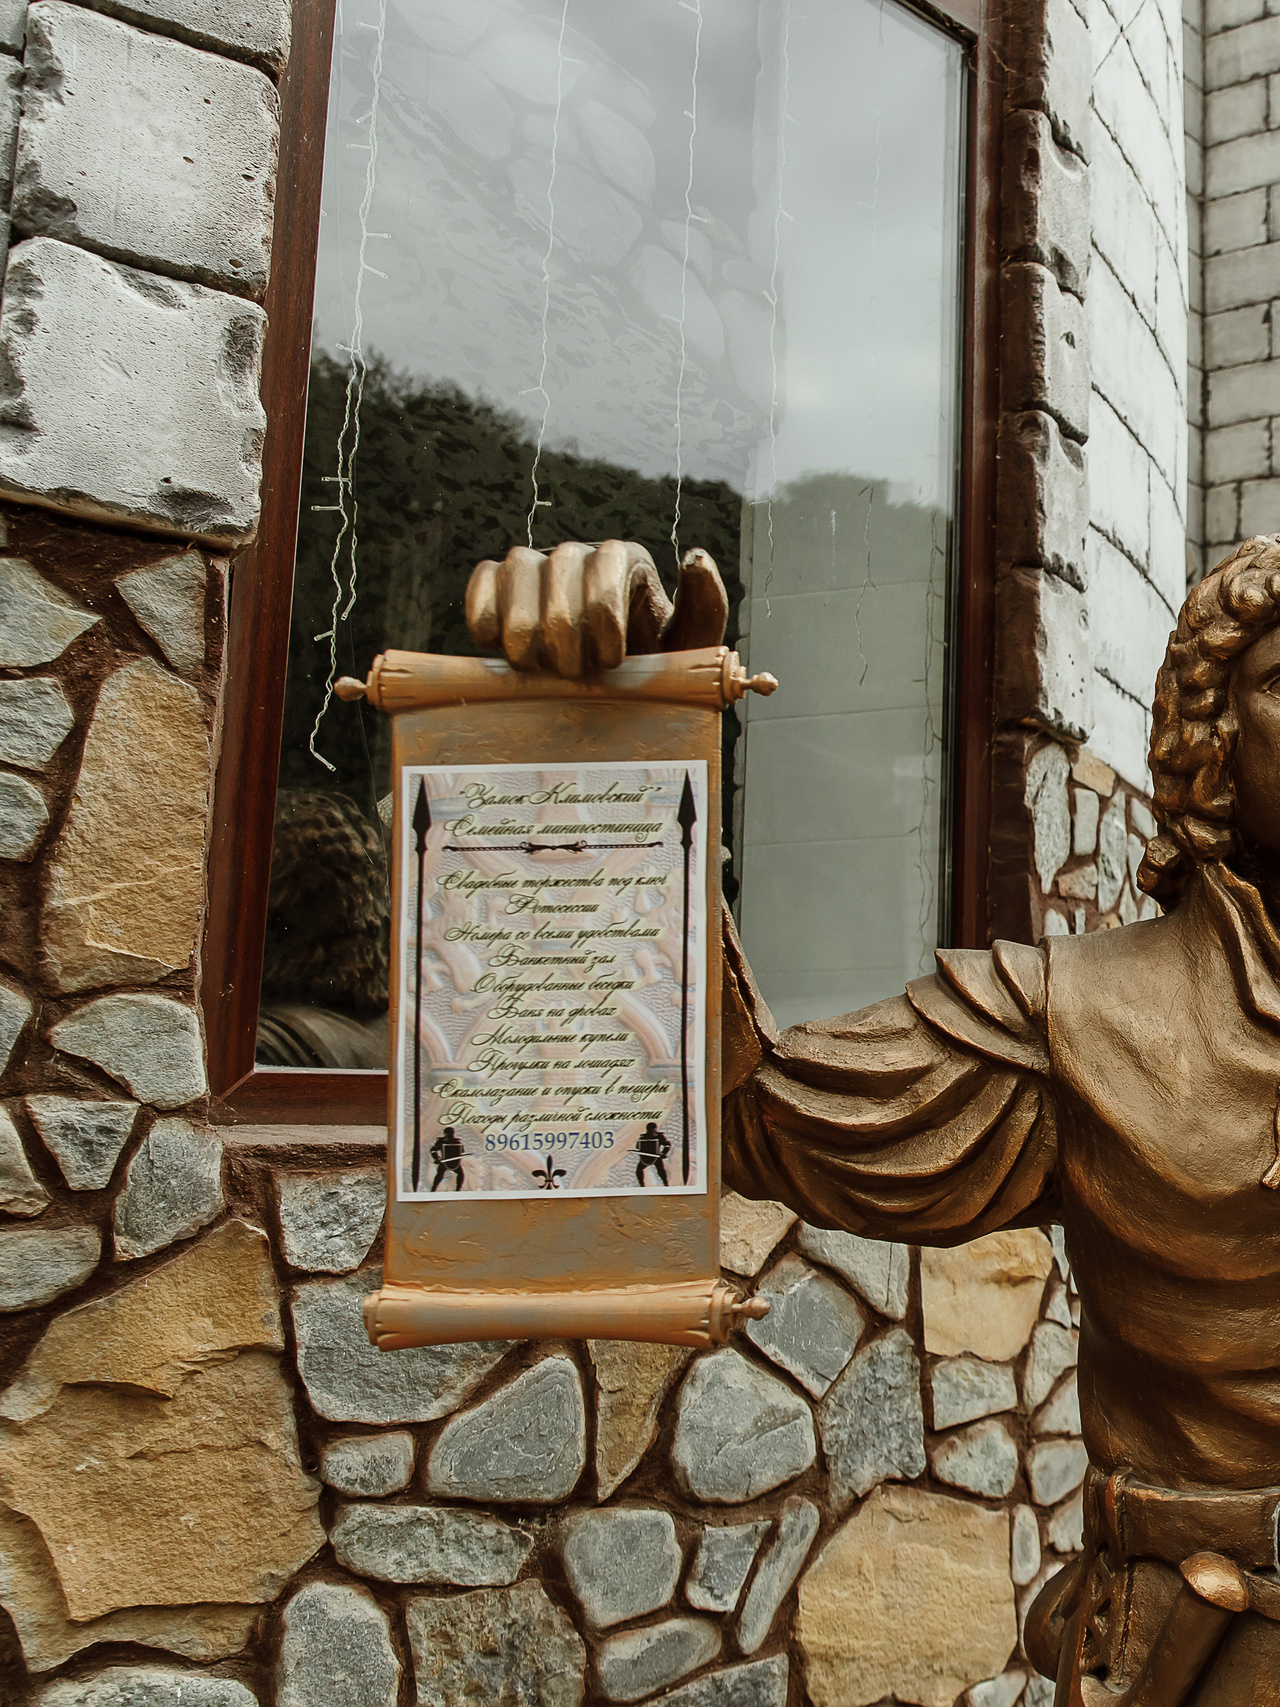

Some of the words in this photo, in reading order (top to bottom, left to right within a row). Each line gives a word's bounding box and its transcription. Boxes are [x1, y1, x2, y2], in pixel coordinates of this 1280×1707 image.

[444, 814, 535, 838] Семейная
[537, 821, 664, 842] минигостиница
[437, 869, 519, 899] Свадебные
[521, 868, 605, 895] торжества
[608, 876, 631, 896] под
[634, 874, 668, 887] ключ
[505, 893, 600, 915] Фотосессии
[444, 921, 513, 948] Номера
[514, 930, 532, 941] со
[533, 921, 574, 941] всеми
[570, 919, 660, 949] удобствами
[488, 942, 592, 968] Банкетный
[584, 953, 616, 974] зал
[470, 972, 586, 1001] Оборудованные
[588, 971, 636, 995] беседки
[487, 995, 543, 1020] Баня
[546, 1007, 565, 1017] на
[560, 998, 618, 1027] дровах
[471, 1026, 576, 1054] Молодильные
[578, 1032, 629, 1052] купели
[467, 1048, 549, 1080] Прогулки
[553, 1059, 571, 1069] на
[573, 1058, 636, 1078] лошадях
[432, 1078, 538, 1107] Скалолазание
[541, 1086, 551, 1096] и
[605, 1076, 623, 1095] в
[618, 1079, 669, 1103] пещеры
[438, 1101, 507, 1133] Походы
[505, 1107, 590, 1132] различной
[585, 1109, 664, 1121] сложности
[485, 1131, 615, 1152] 89615997403
